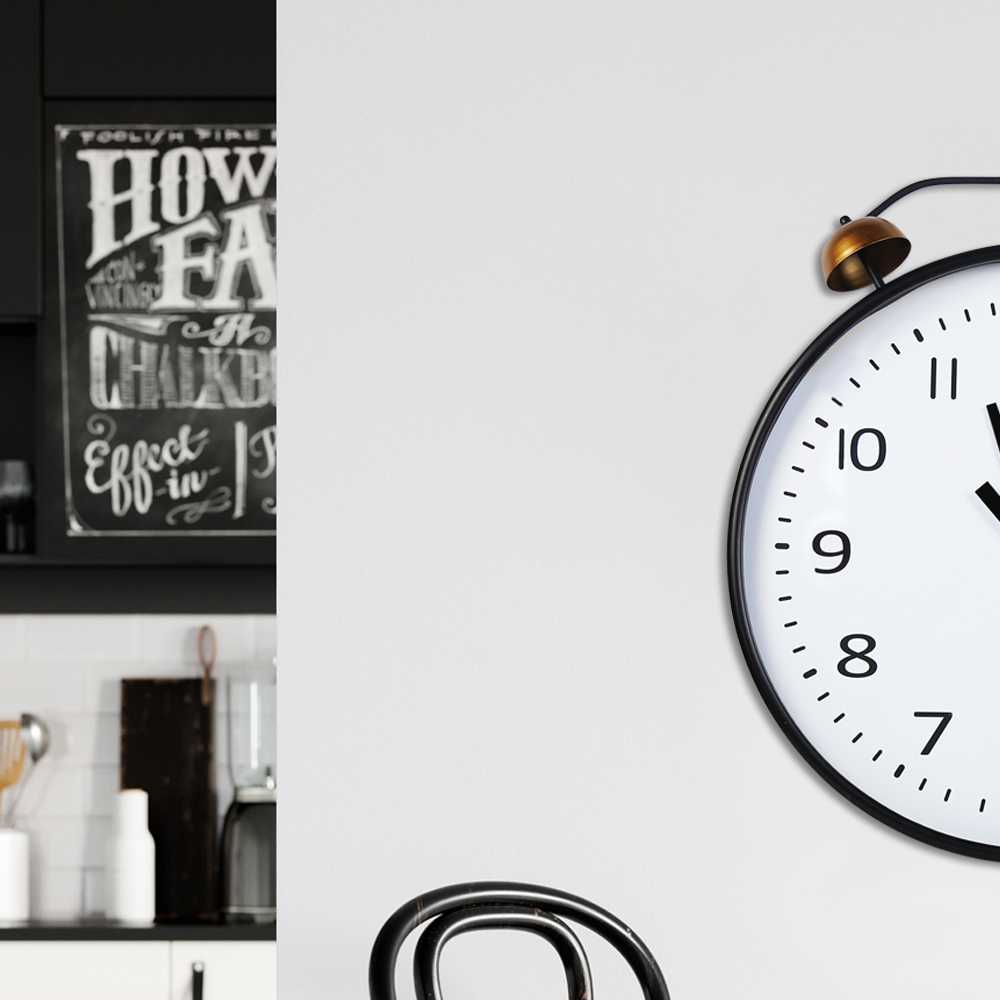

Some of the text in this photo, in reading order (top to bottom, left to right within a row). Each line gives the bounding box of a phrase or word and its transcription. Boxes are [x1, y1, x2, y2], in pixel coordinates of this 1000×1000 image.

[76, 146, 276, 269] HOW
[152, 197, 276, 312] EA
[89, 325, 276, 409] CHALKB
[931, 358, 957, 399] 11
[84, 414, 210, 516] Effect
[839, 429, 886, 471] 10
[813, 530, 850, 574] 9
[838, 634, 877, 678] 8
[914, 712, 952, 755] 7
